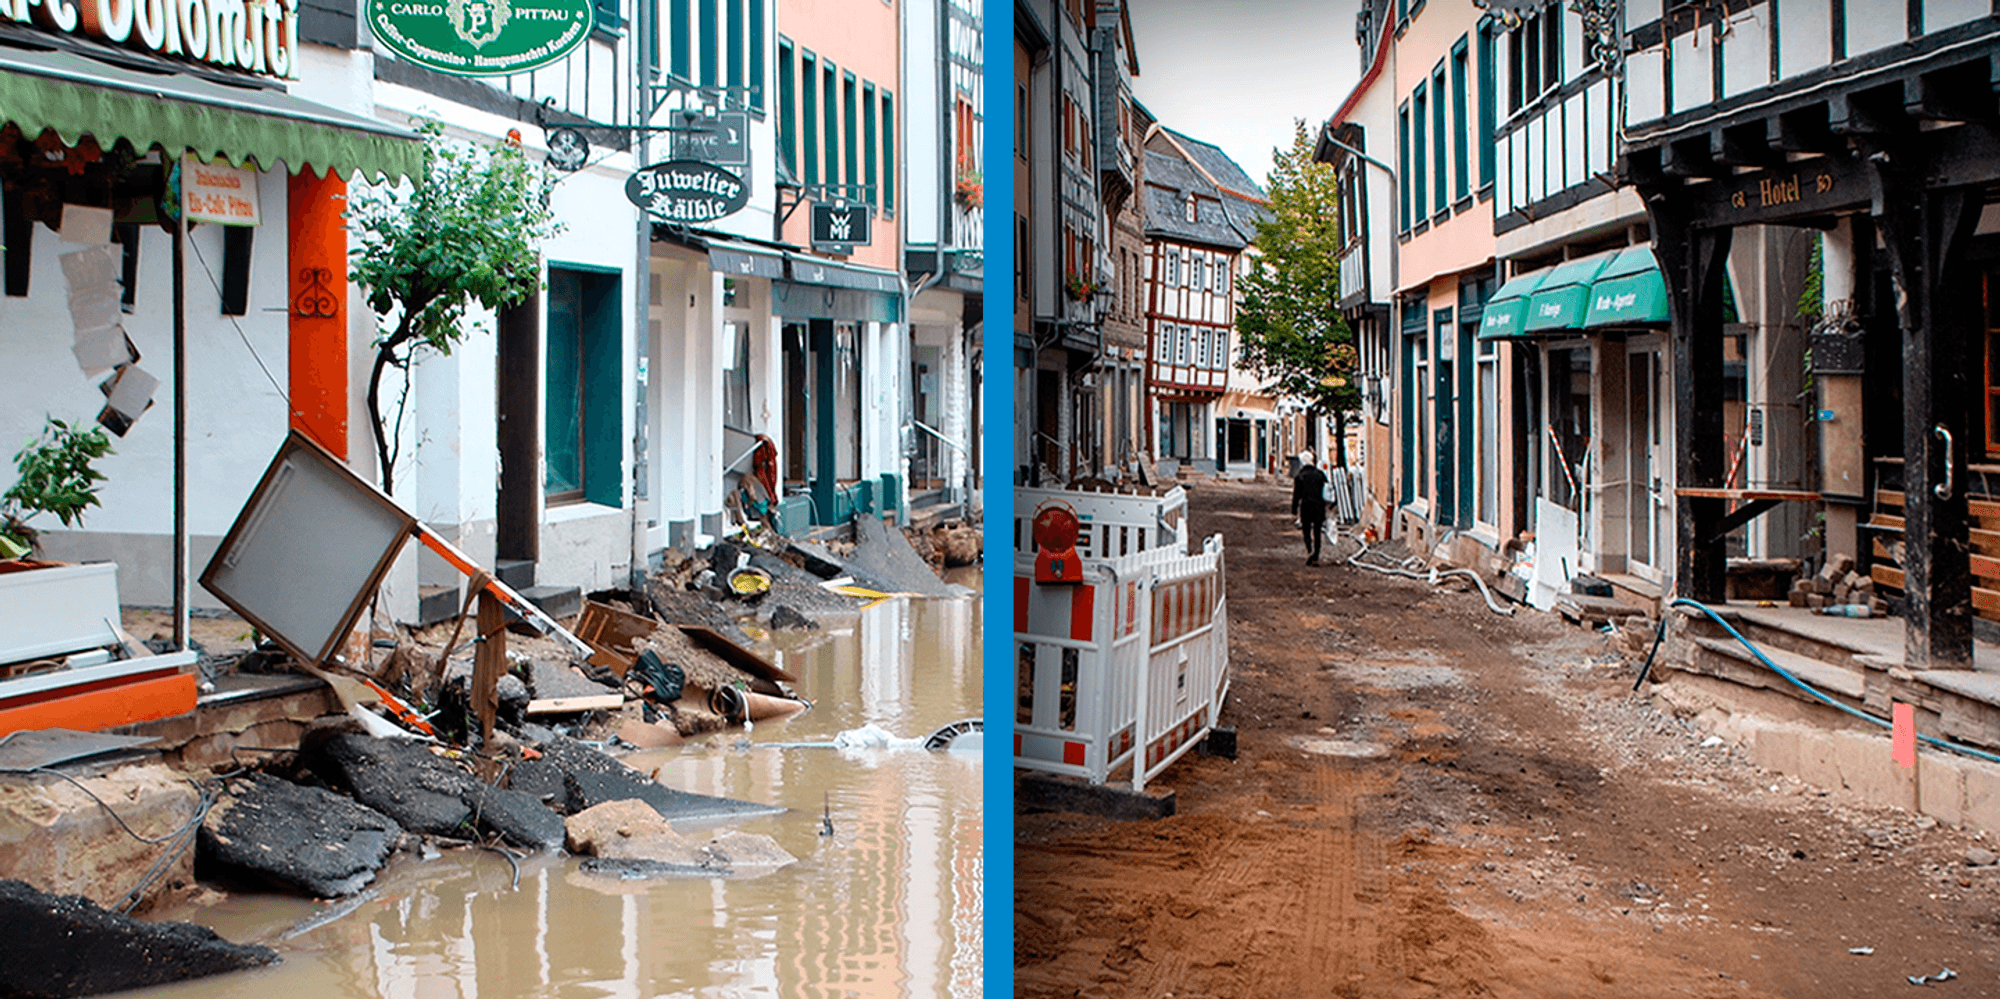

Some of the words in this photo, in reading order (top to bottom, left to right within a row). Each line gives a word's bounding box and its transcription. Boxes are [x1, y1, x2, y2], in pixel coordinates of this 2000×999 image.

[391, 3, 443, 17] CARLO
[515, 7, 569, 21] PITTAU
[546, 21, 582, 54] Kuchen
[636, 169, 741, 199] Juwelier
[1760, 173, 1800, 207] Hotel
[645, 192, 727, 219] Kälble
